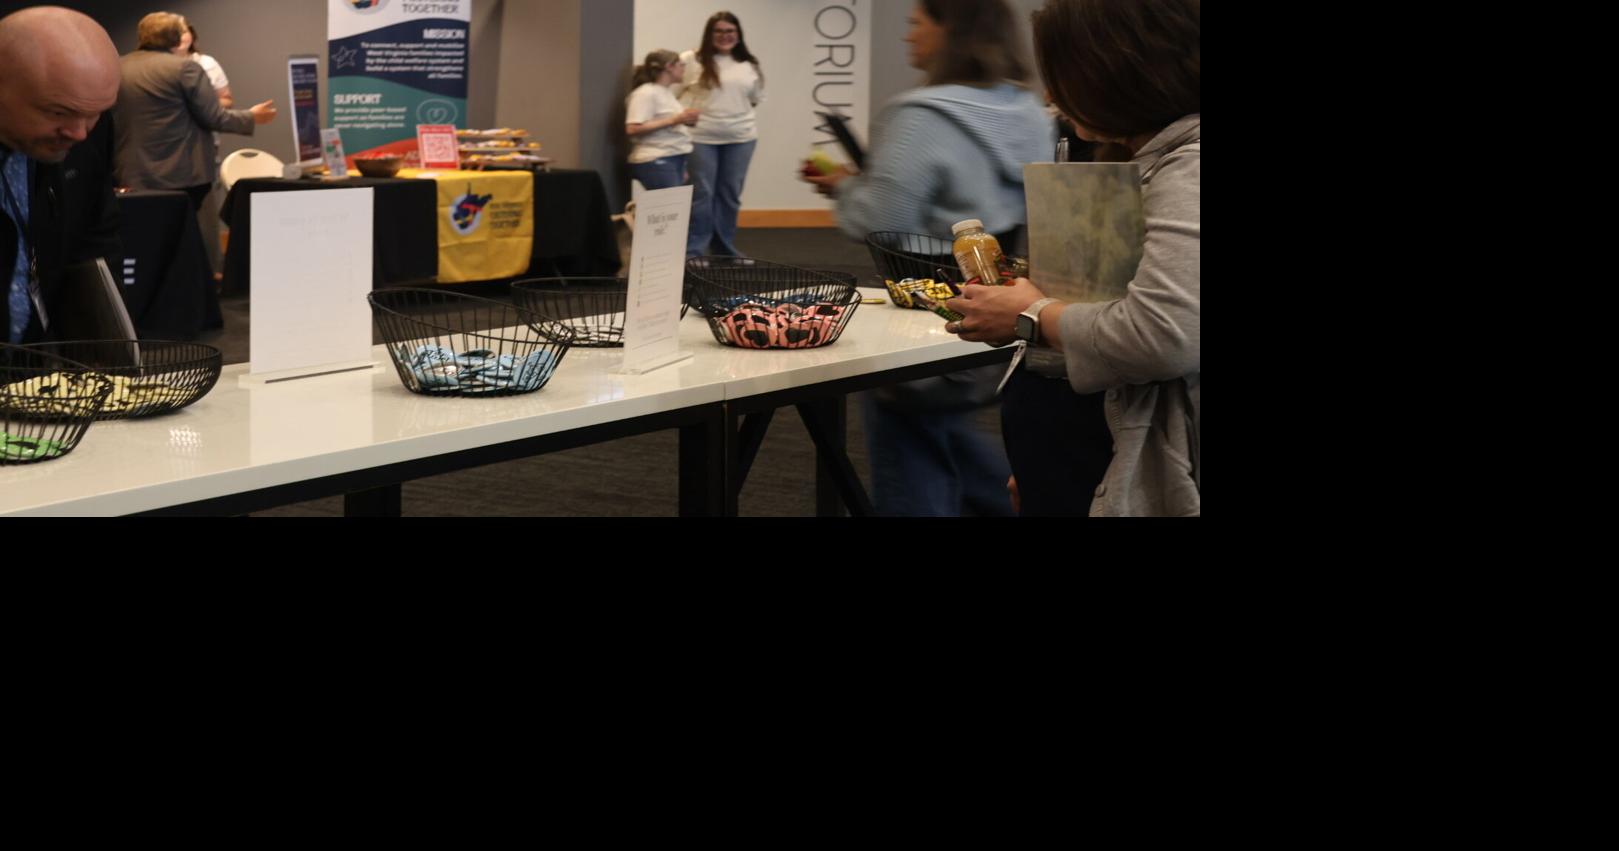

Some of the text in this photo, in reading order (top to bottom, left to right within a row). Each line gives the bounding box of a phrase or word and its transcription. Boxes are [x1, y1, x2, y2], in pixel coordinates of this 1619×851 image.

[402, 4, 458, 14] TOGETHER
[423, 28, 466, 39] MISSION
[812, 0, 856, 146] ORIUM
[334, 93, 382, 105] SUPPORT
